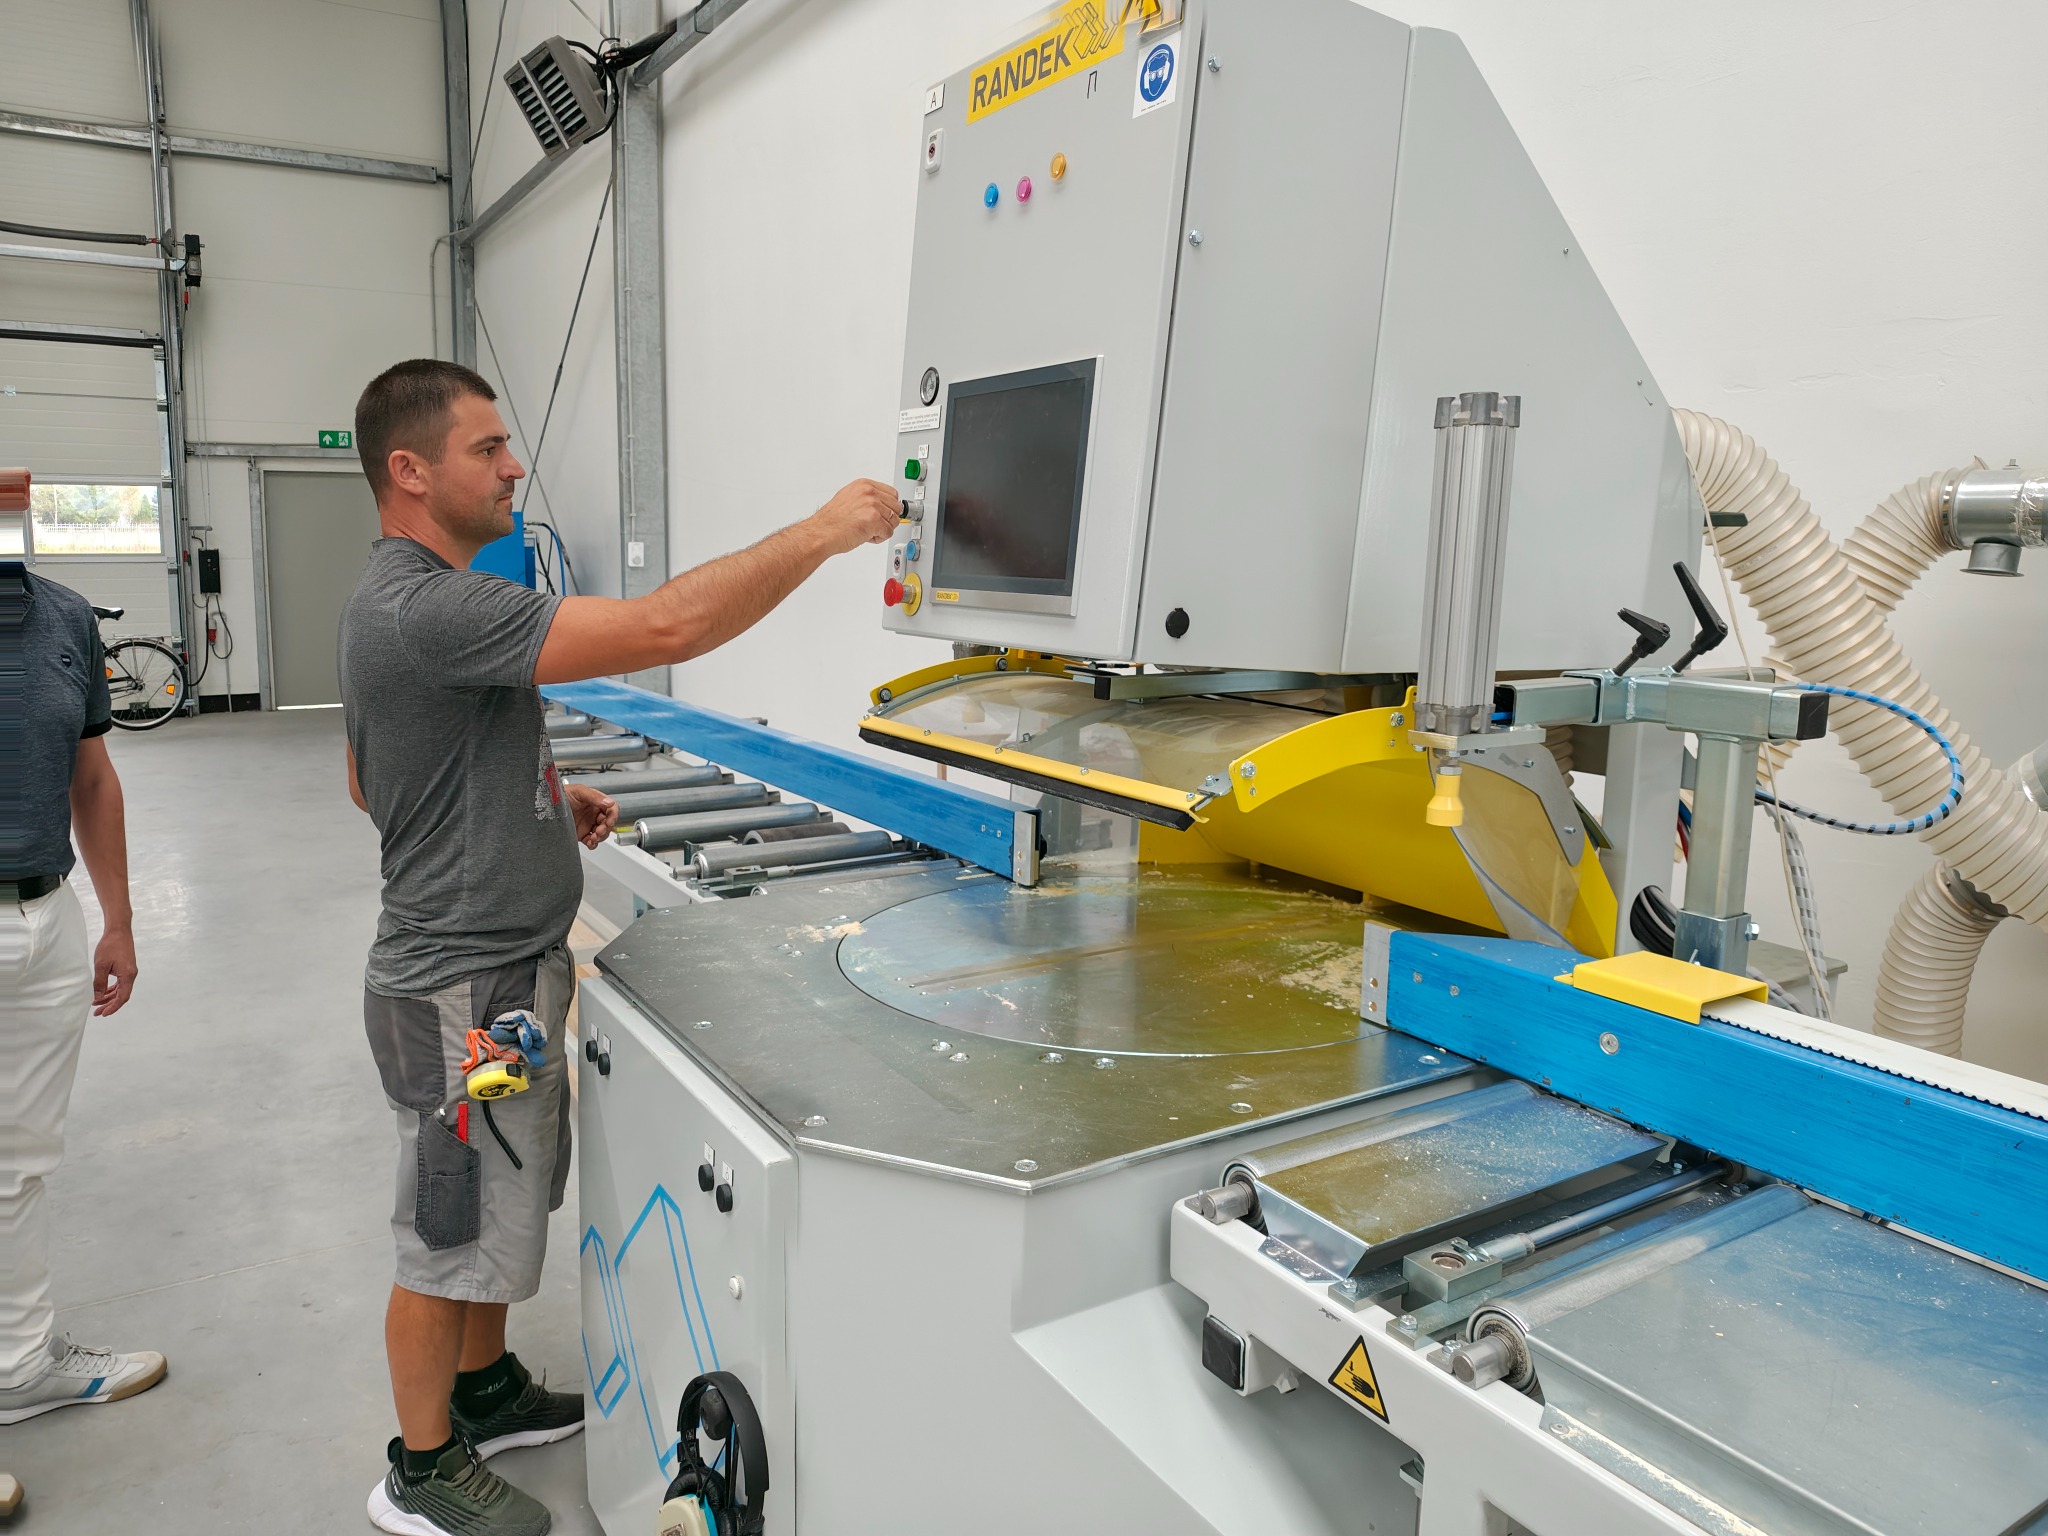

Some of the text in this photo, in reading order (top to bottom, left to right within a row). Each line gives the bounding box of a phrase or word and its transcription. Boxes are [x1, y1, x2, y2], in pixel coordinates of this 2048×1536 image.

[972, 27, 1075, 113] RANDEK
[930, 91, 937, 109] A
[936, 591, 952, 600] RANDEK
